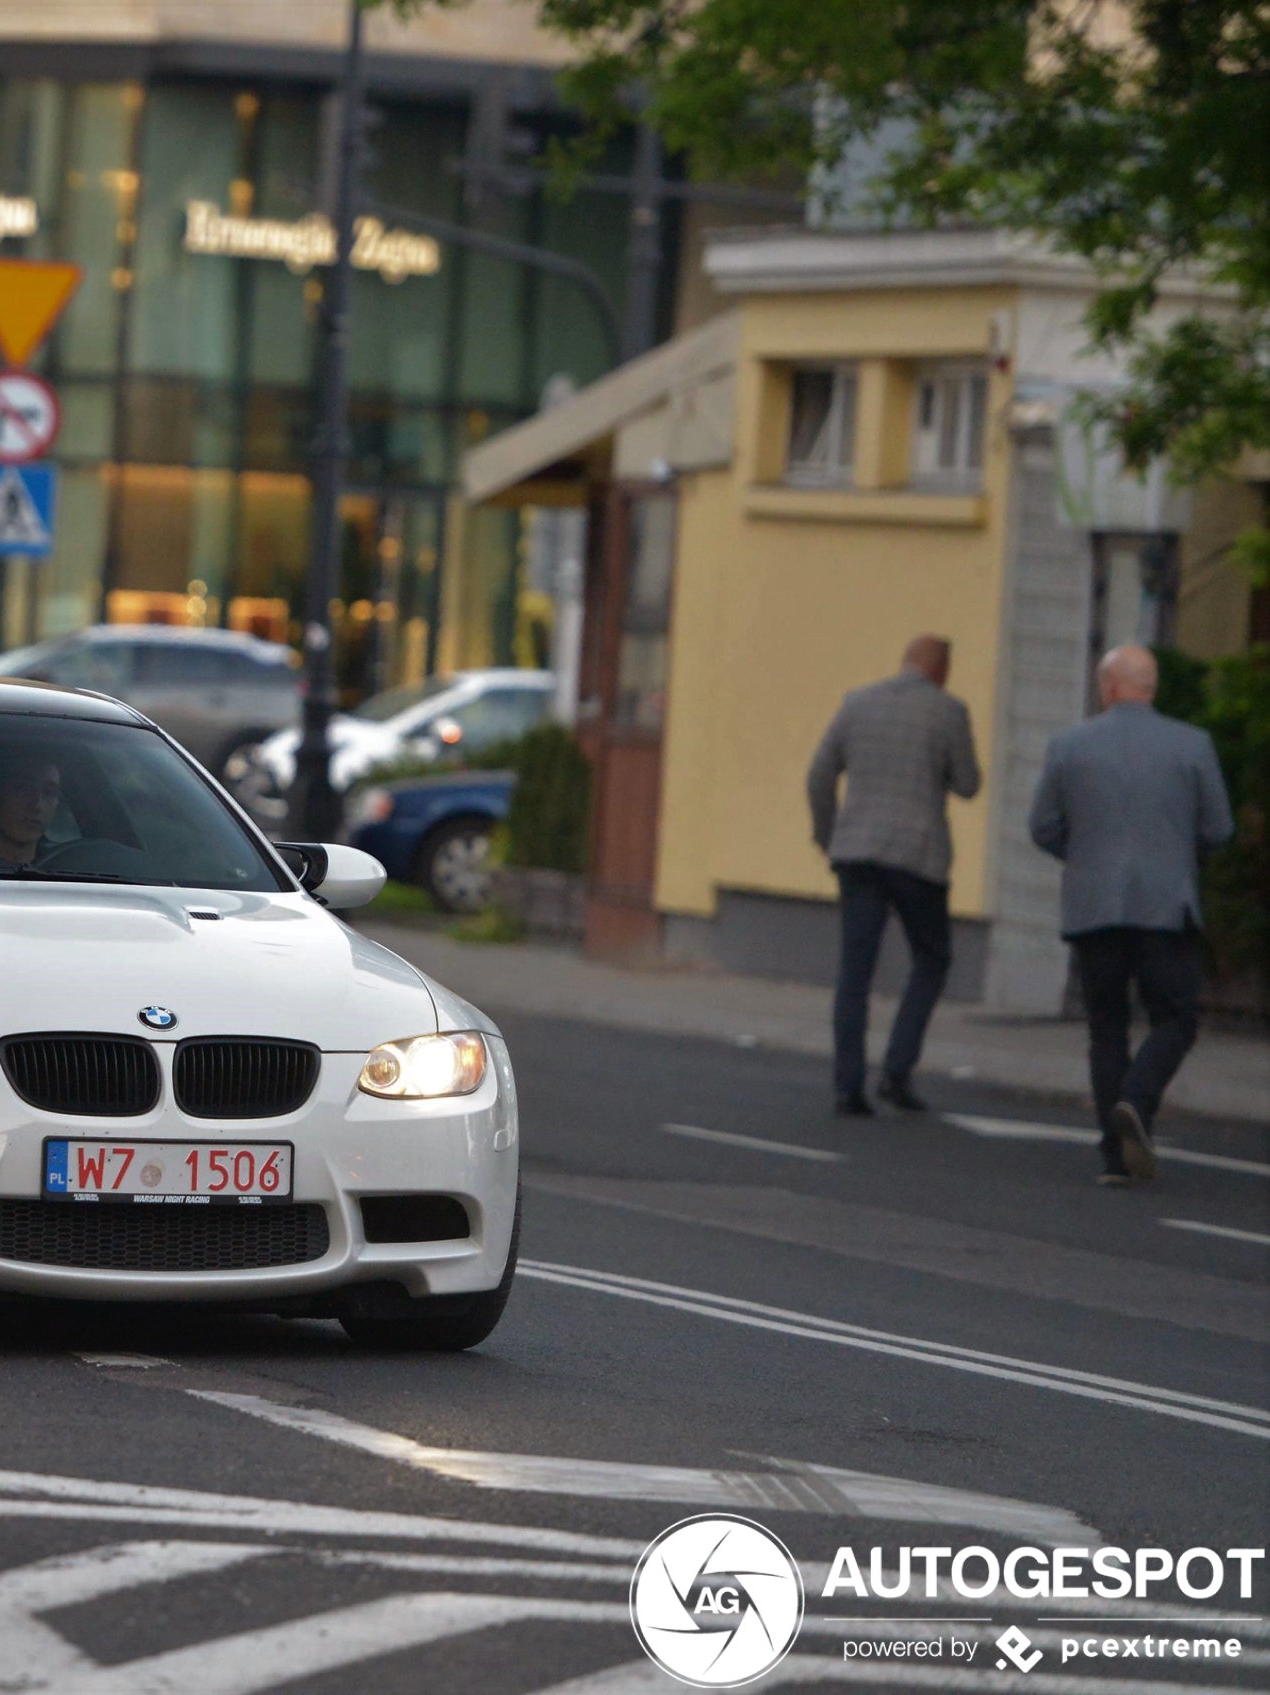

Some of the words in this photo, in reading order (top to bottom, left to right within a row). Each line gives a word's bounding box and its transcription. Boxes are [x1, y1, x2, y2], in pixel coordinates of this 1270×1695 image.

[78, 1147, 135, 1190] W7
[185, 1149, 280, 1192] 1506
[49, 1172, 65, 1185] PL
[133, 1194, 164, 1203] WARSAW
